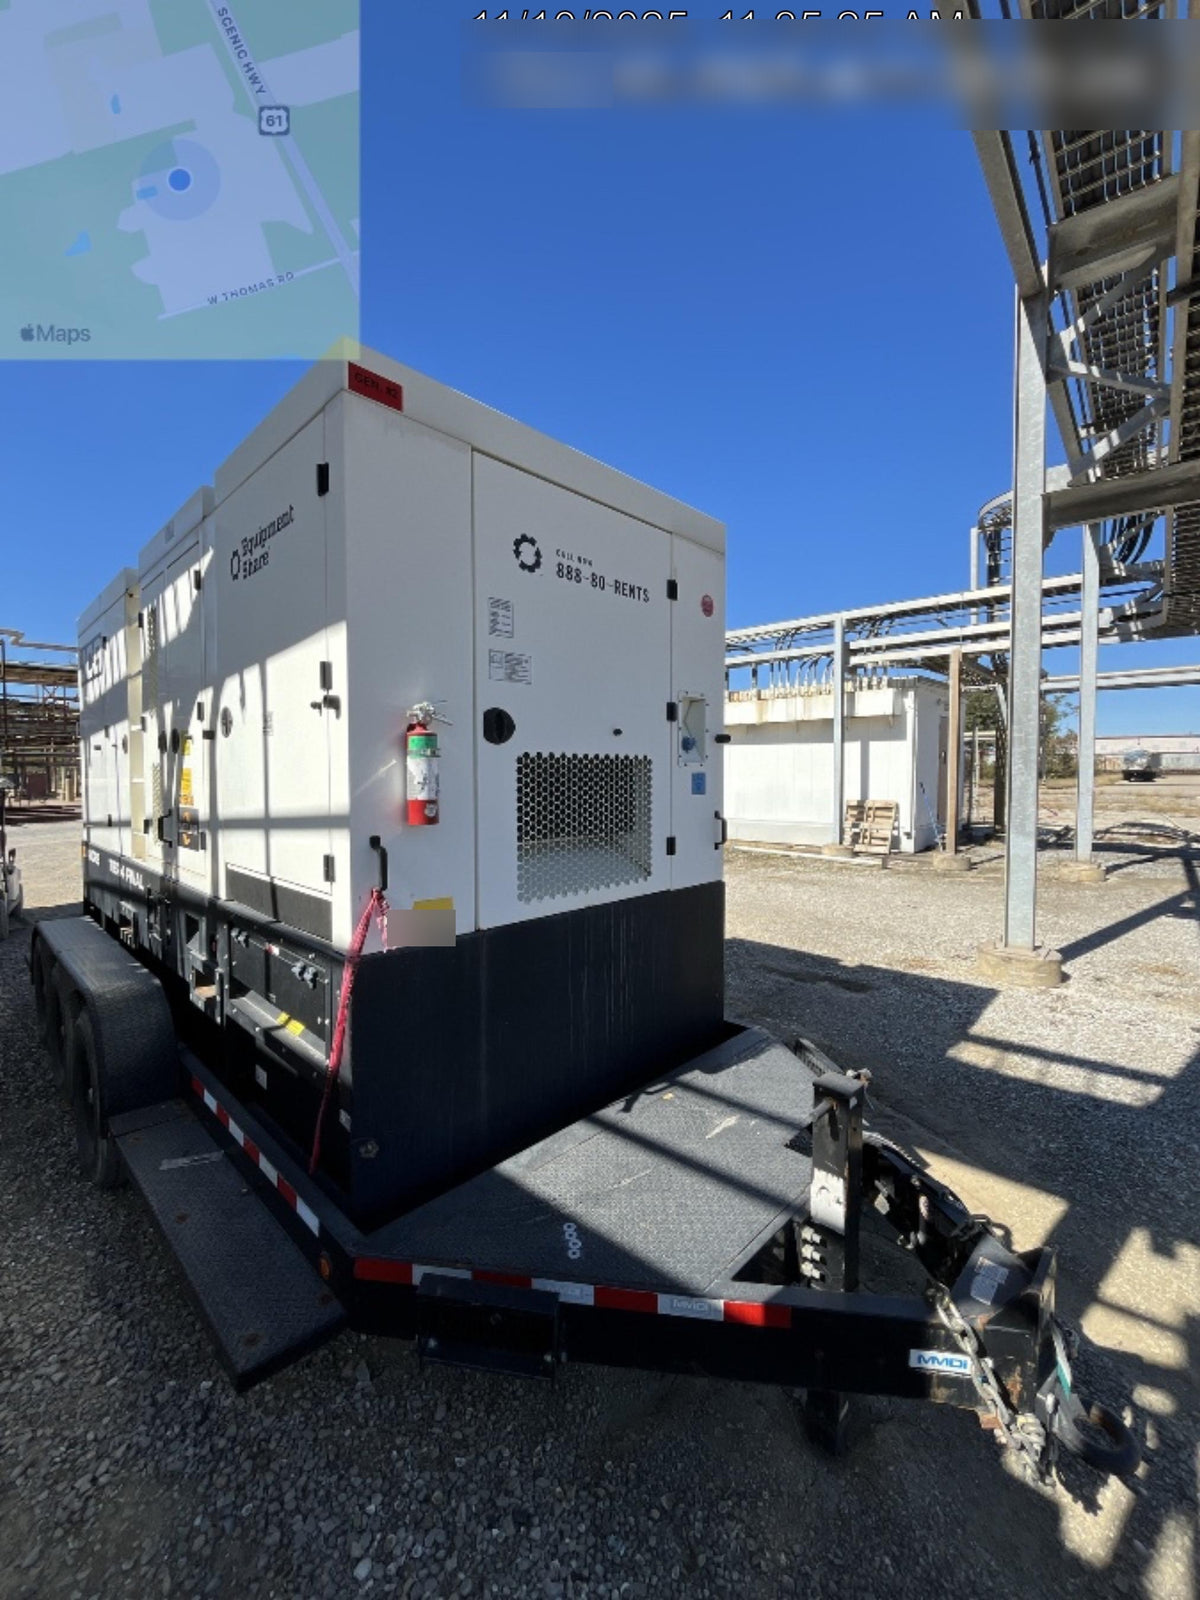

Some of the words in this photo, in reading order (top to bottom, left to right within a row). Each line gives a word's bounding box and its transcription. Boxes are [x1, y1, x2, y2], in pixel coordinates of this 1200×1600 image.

[241, 504, 294, 557] Equipment
[243, 551, 269, 580] Share
[556, 562, 650, 603] 888-80-RENTS
[917, 1353, 968, 1370] MMDI
